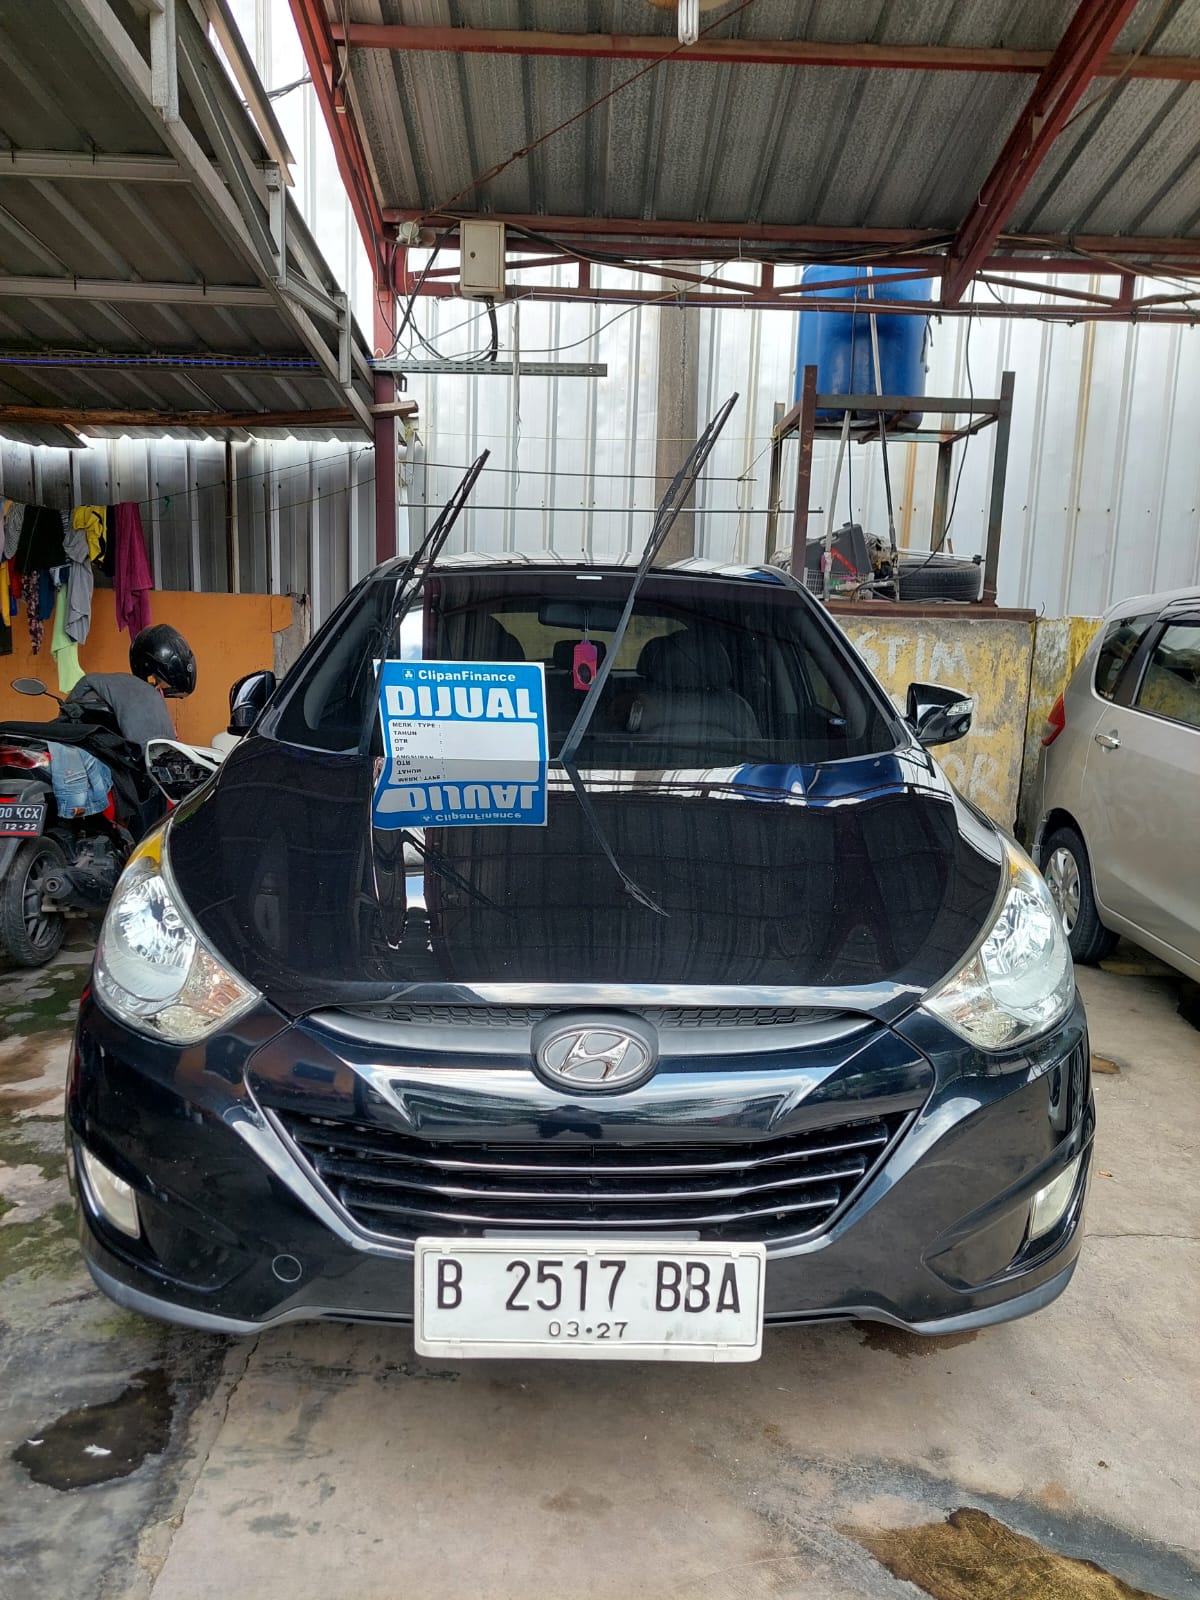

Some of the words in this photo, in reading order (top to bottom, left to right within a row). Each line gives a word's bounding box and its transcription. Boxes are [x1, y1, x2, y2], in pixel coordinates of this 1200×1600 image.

[418, 670, 516, 682] ClipanFinance
[385, 685, 538, 719] DIJUAL
[437, 1259, 463, 1310] B
[505, 1260, 627, 1312] 2517
[655, 1261, 741, 1314] BBA
